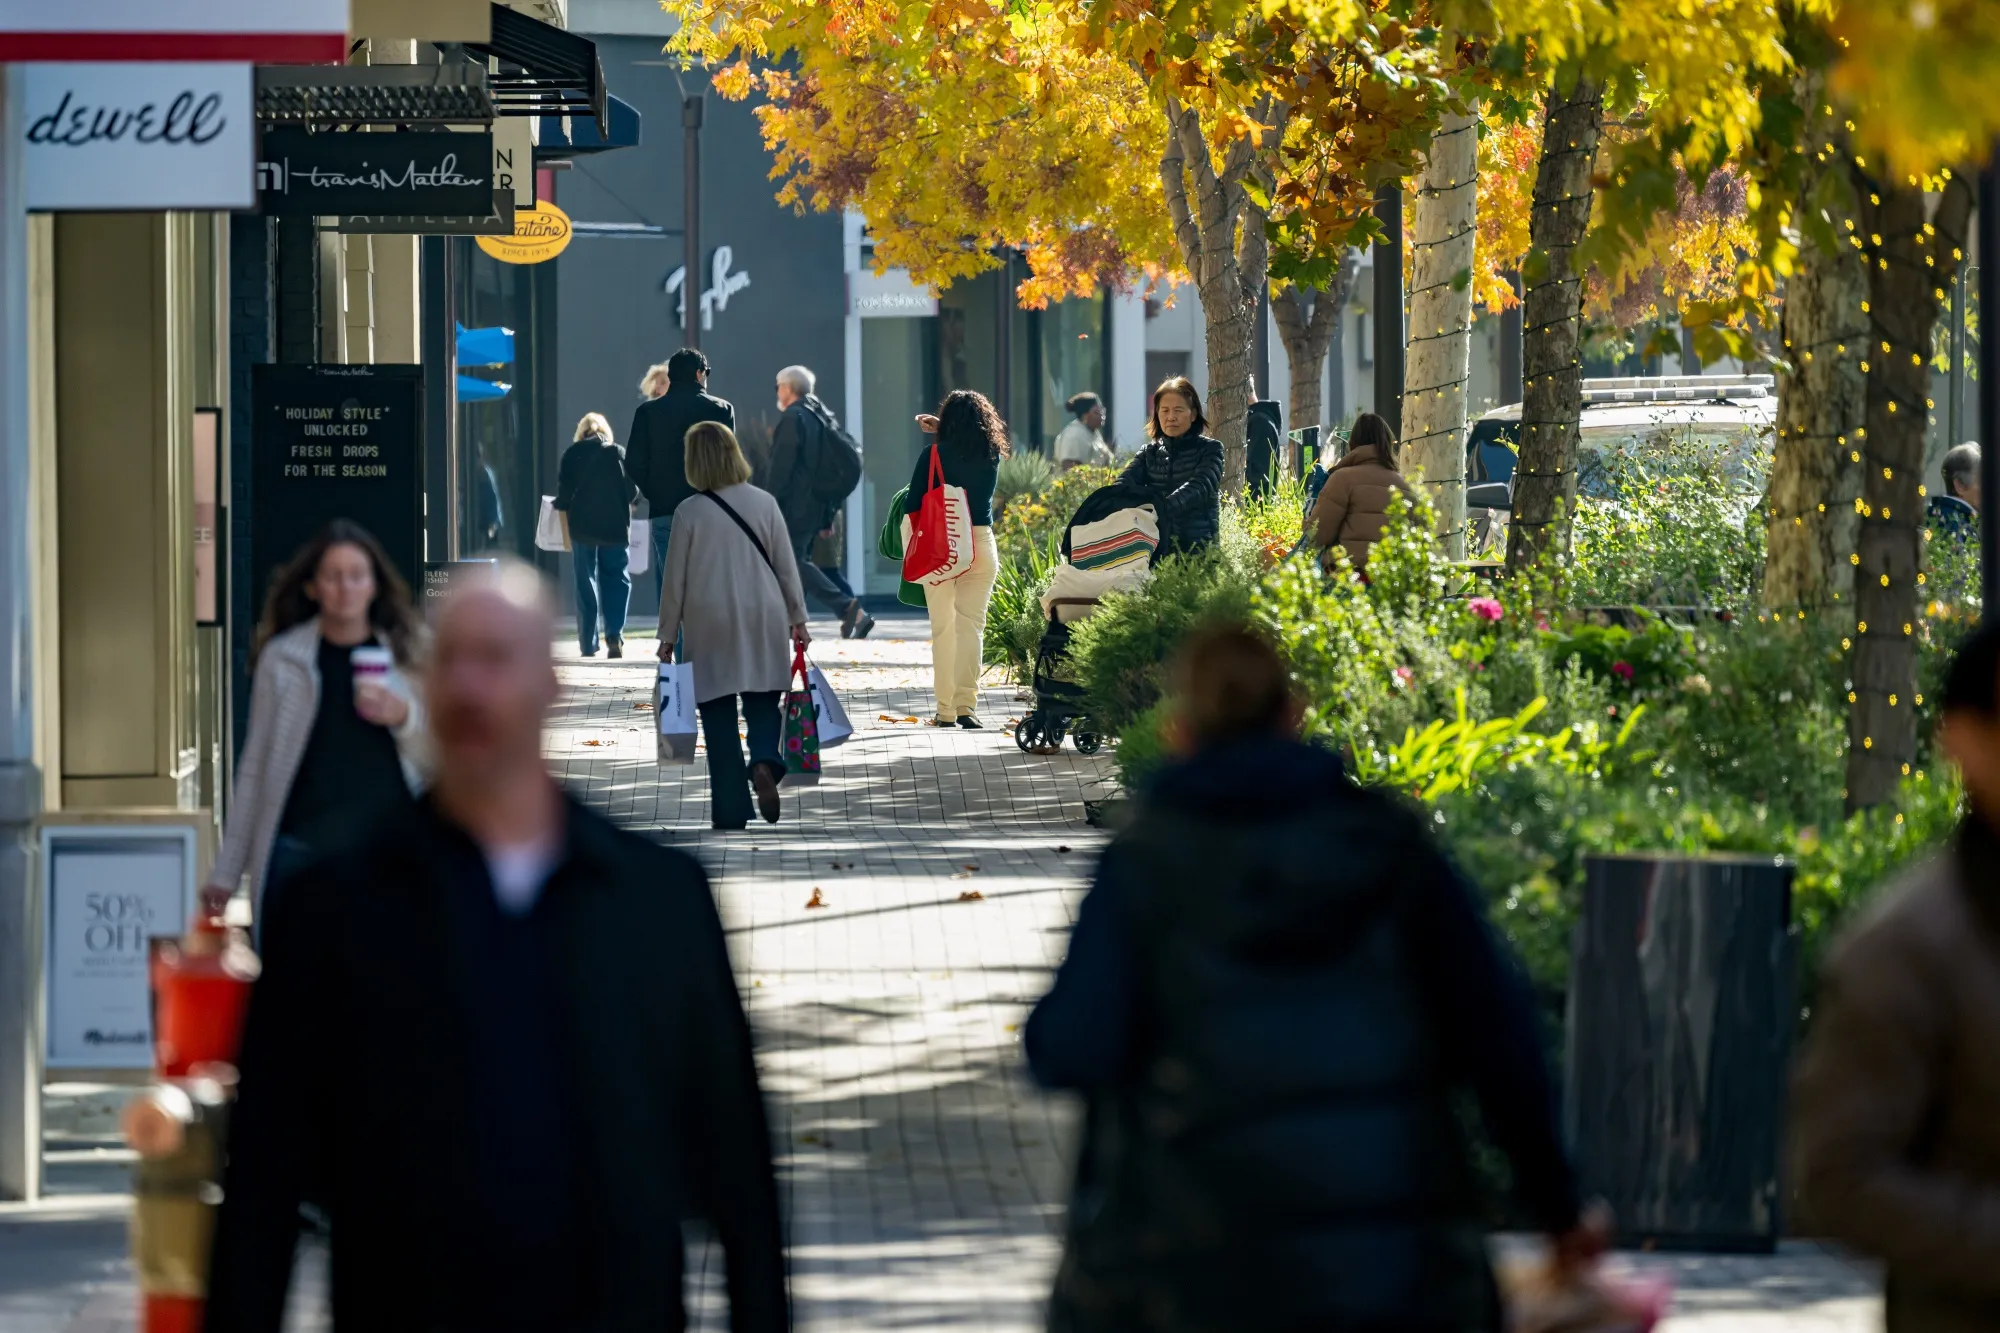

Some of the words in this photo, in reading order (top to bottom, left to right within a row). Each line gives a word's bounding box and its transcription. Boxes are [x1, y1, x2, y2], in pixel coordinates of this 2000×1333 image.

[286, 408, 334, 419] HOLIDAY
[343, 408, 381, 419] STYLE
[304, 424, 368, 436] UNLOCKED
[291, 445, 332, 457] FRESH
[343, 445, 379, 457] DROPS
[284, 464, 308, 476] FOR
[313, 464, 336, 476] THE
[342, 465, 387, 477] SEASON
[929, 498, 961, 577] lululemon
[85, 893, 154, 922] 50%
